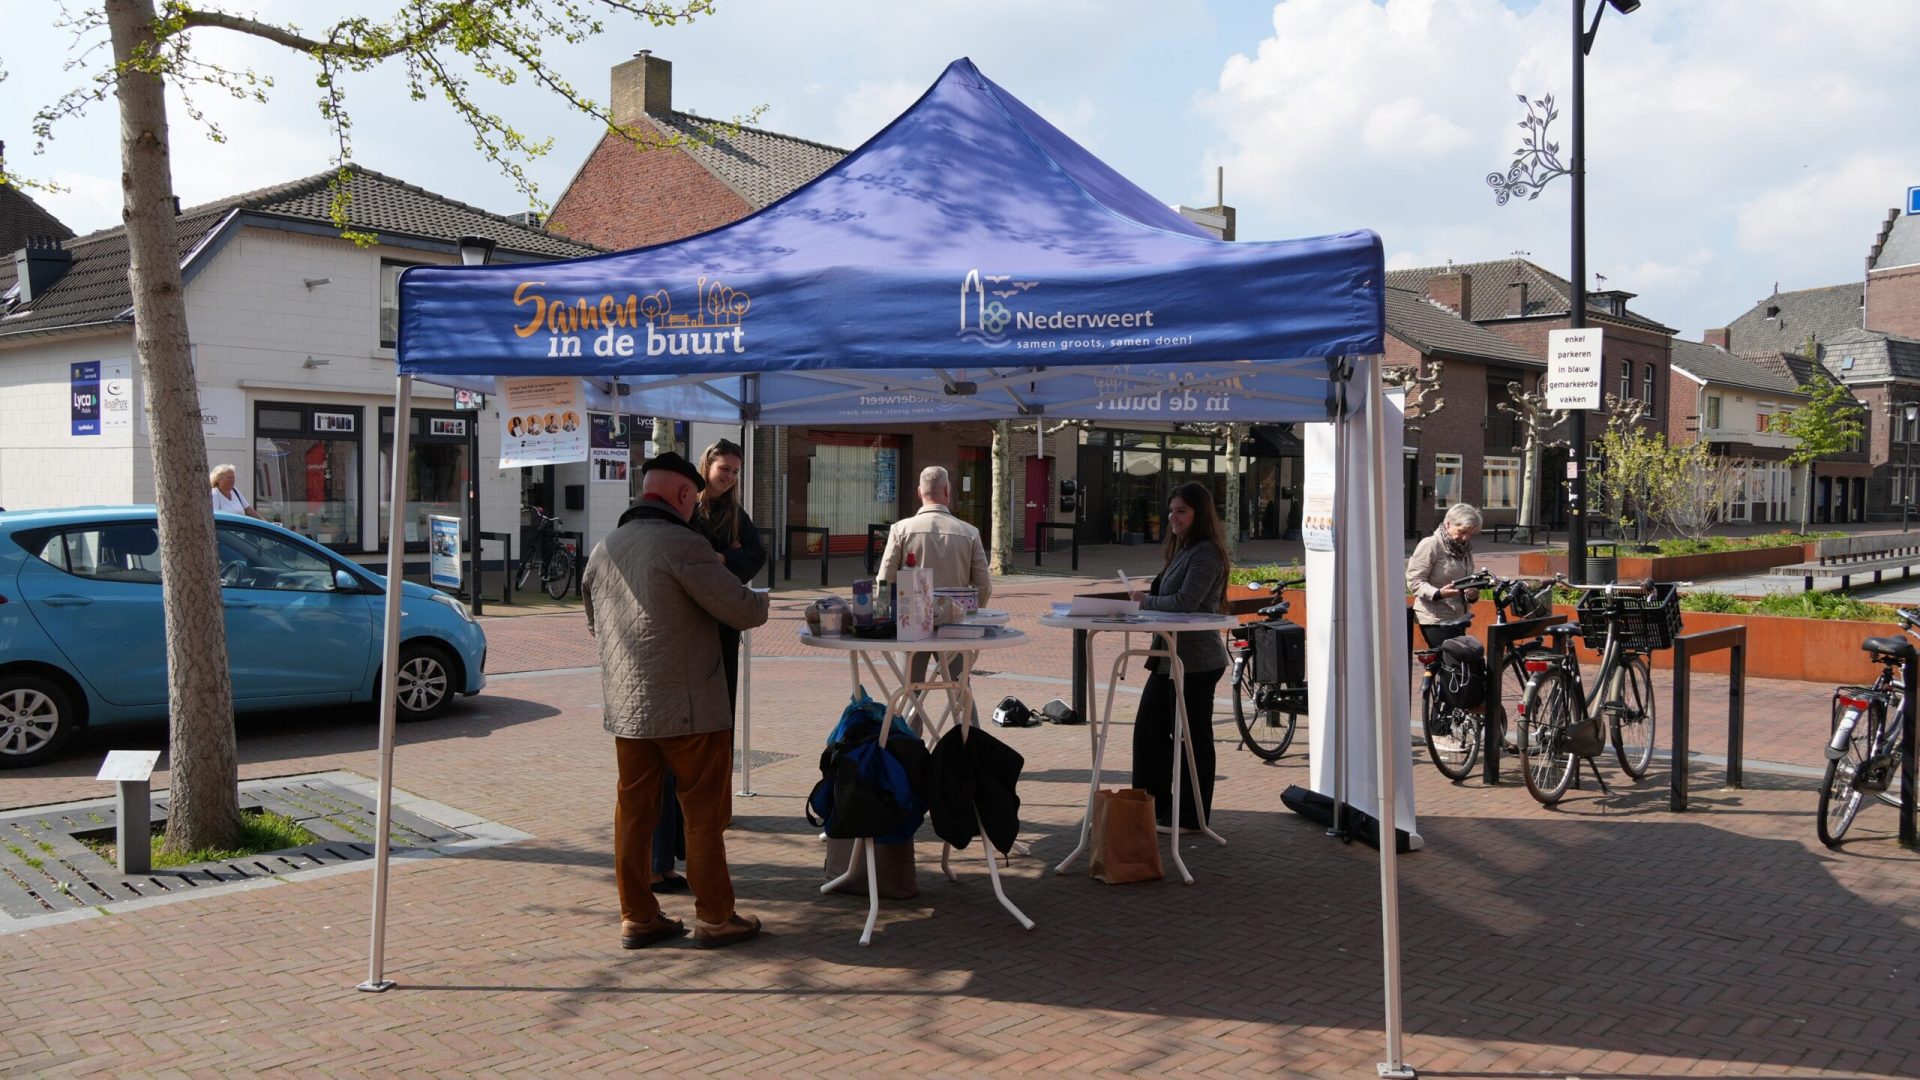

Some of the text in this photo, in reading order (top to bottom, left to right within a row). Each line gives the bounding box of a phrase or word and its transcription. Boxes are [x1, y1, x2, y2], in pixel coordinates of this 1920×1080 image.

[513, 281, 638, 337] Samen
[1016, 310, 1153, 330] Nederweert
[547, 322, 745, 357] in de buurt
[1017, 335, 1192, 350] samen groots, samen doen!
[1564, 335, 1586, 343] enkel
[1557, 350, 1592, 359] parkeren
[1549, 381, 1598, 390] gemarkeerde
[74, 392, 91, 410] Lyca
[202, 415, 218, 423] one
